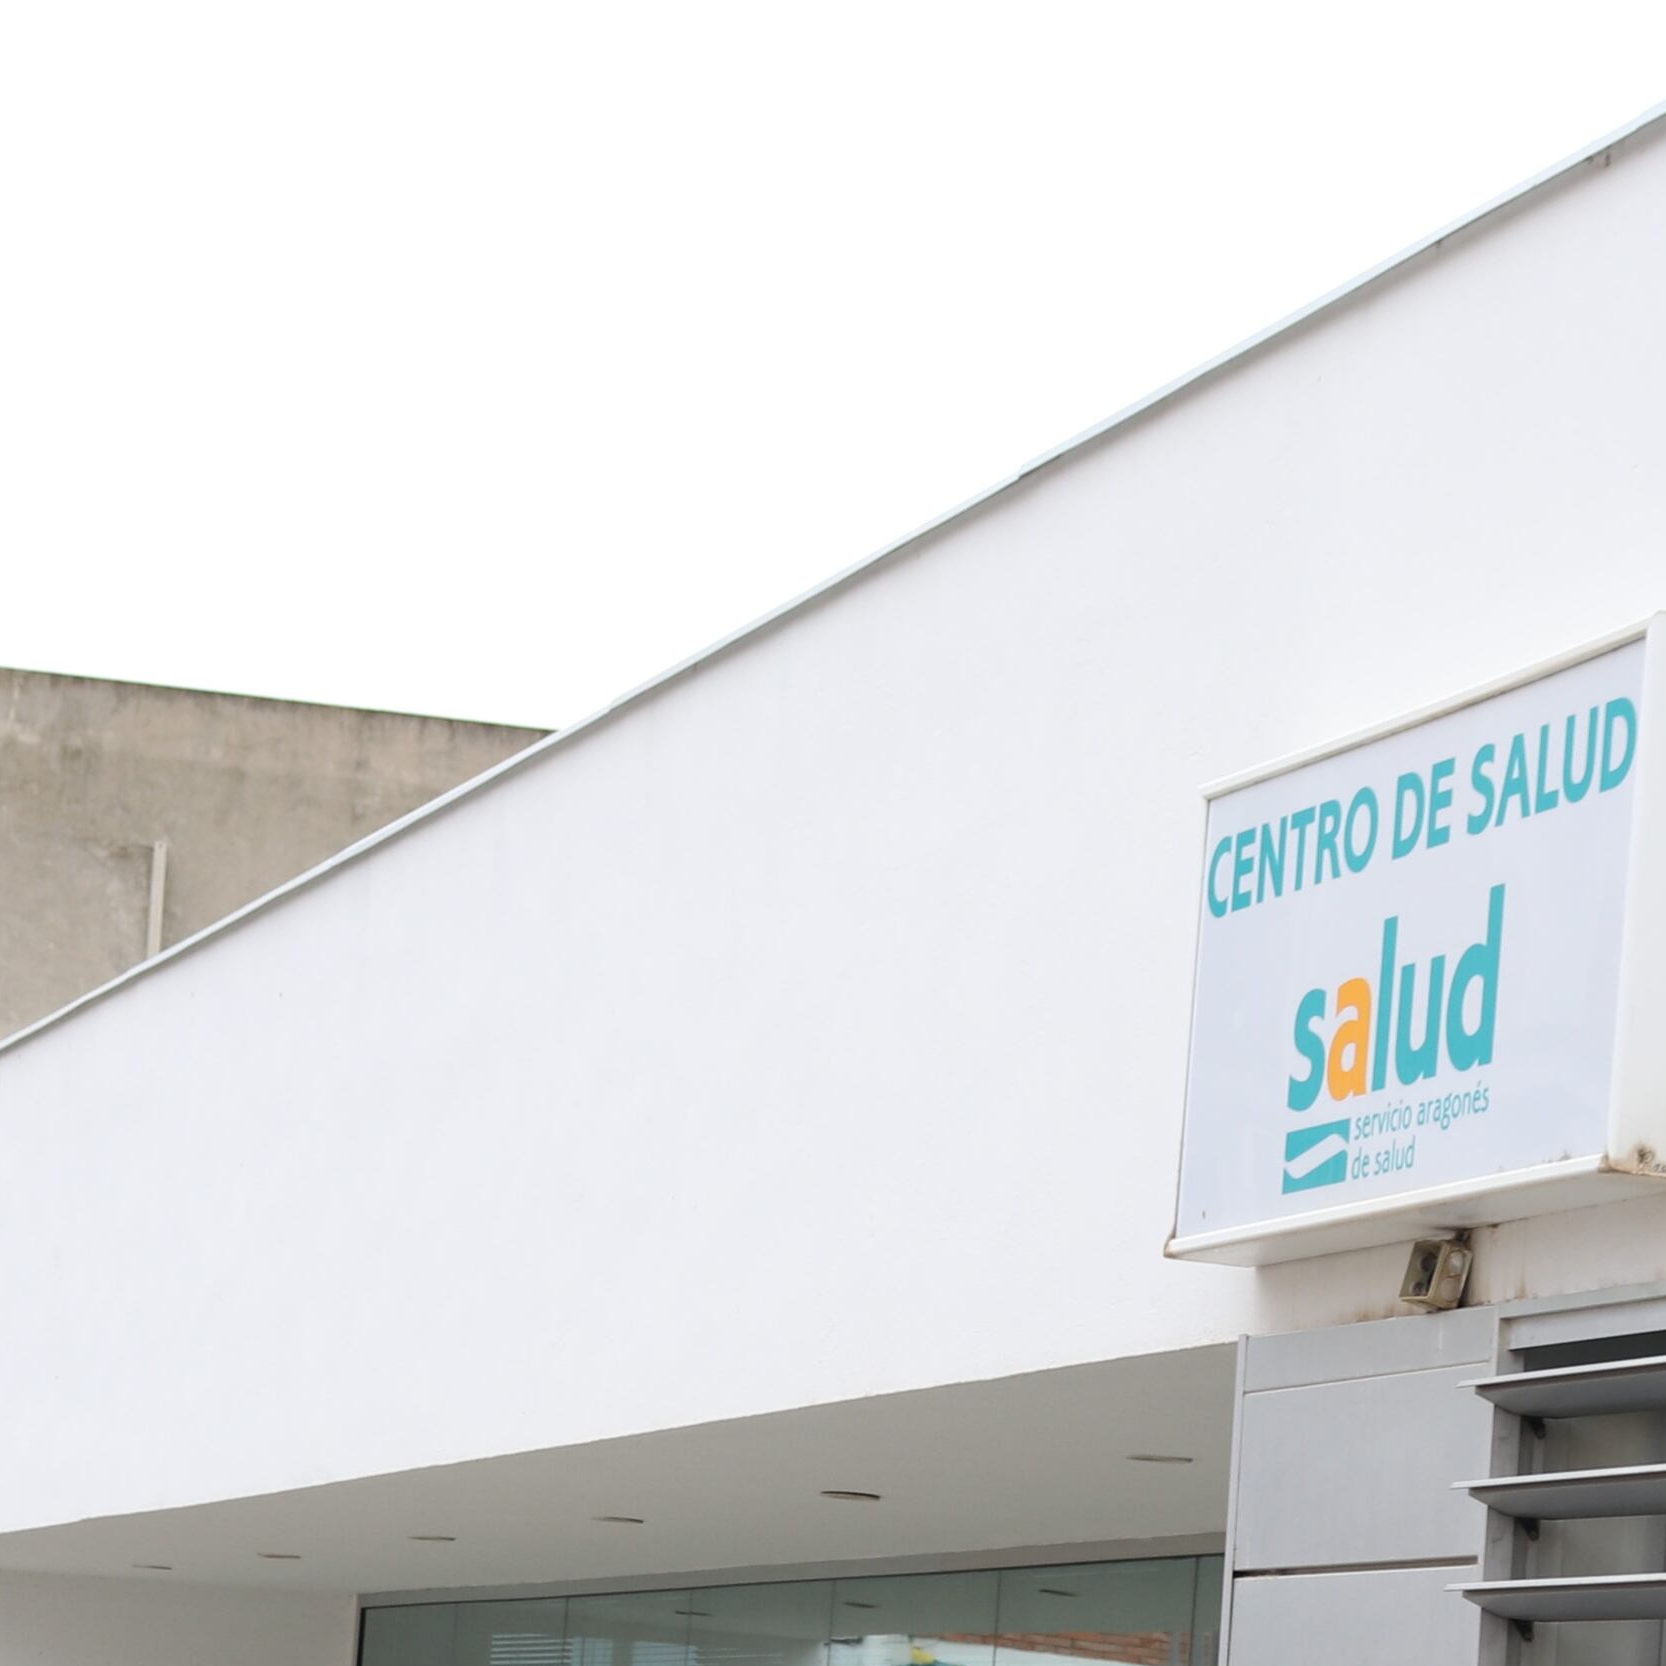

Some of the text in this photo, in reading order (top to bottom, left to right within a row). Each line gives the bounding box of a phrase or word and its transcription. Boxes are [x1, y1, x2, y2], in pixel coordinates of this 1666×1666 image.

[1207, 696, 1638, 919] CENTRO DE SALUD
[1286, 883, 1506, 1113] salud
[1351, 1136, 1416, 1181] de salud
[1353, 1081, 1490, 1141] servicio aragonés
